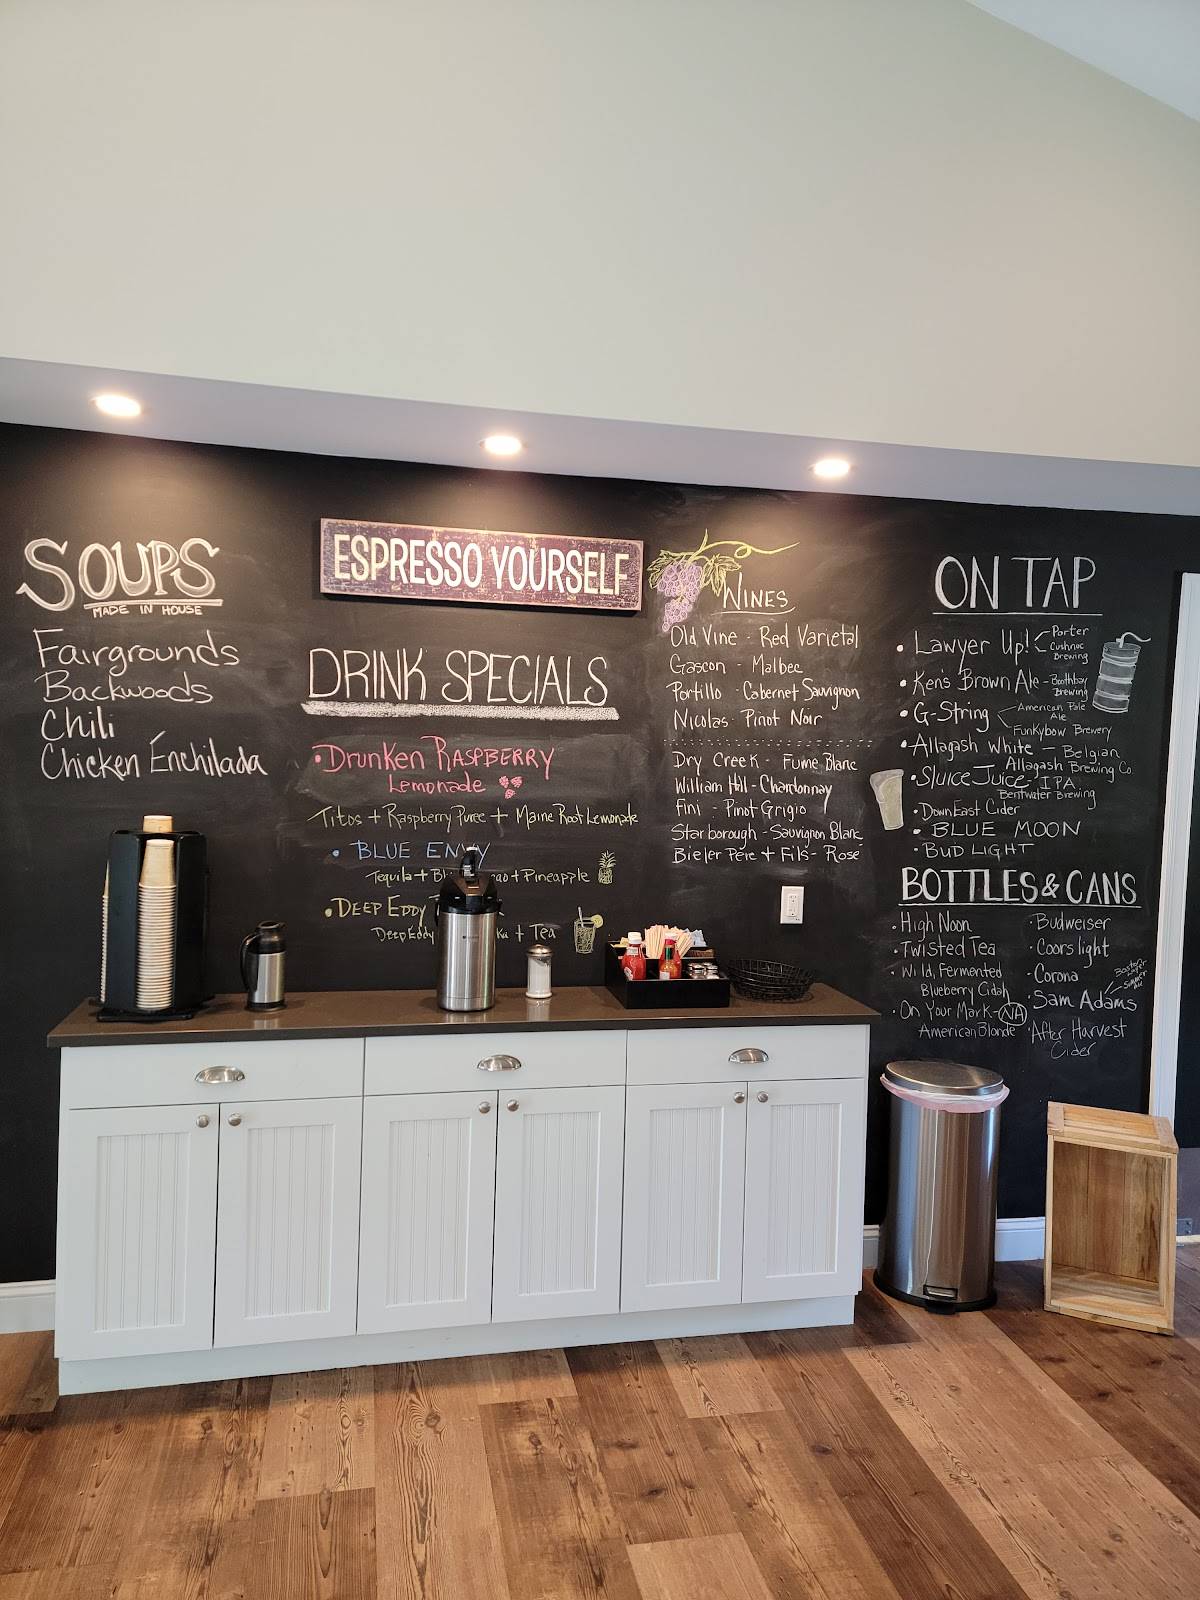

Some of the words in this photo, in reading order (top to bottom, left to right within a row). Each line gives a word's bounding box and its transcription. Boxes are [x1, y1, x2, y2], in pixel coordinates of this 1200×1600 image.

[16, 538, 220, 611] SOUPS
[334, 534, 483, 589] ESPRESSO
[490, 545, 630, 596] YOURSELF
[934, 555, 1000, 610] ON
[1011, 556, 1097, 609] TAP
[93, 605, 130, 618] MADE
[140, 604, 153, 615] IN
[162, 604, 203, 615] HOUSE
[671, 624, 697, 647] Old
[702, 624, 738, 646] Vine
[760, 622, 789, 648] Red
[798, 624, 858, 648] Varietal
[1052, 624, 1090, 638] Porter
[33, 628, 240, 676] Fairgrounds
[914, 630, 991, 675] Lawyer
[1001, 628, 1030, 666] Up!
[1053, 652, 1089, 665] Brewing
[669, 654, 726, 674] Gascon
[752, 654, 803, 674] Malbec
[34, 670, 213, 703] Backwoods
[309, 647, 427, 701] DRINK
[441, 649, 609, 707] SPECIALS
[957, 667, 1011, 692] Brown
[1014, 667, 1040, 695] Ale
[666, 681, 722, 702] Portillo
[1052, 687, 1089, 703] Brewing
[913, 700, 990, 733] G-String
[1017, 702, 1064, 712] American
[1066, 701, 1086, 711] Pale
[1050, 713, 1068, 721] Ale
[41, 705, 115, 741] Chili
[674, 709, 729, 730] Nicolas
[740, 708, 780, 728] Pinot
[790, 707, 823, 726] Noir
[1072, 723, 1113, 743] Brewery
[908, 733, 979, 761] Allagash
[988, 736, 1034, 755] White
[1062, 744, 1120, 765] Belgian
[41, 742, 140, 781] Chicken
[672, 751, 702, 776] Dry
[822, 752, 858, 772] Blanc
[1005, 756, 1064, 780] Allagash
[1067, 760, 1115, 784] Brewing
[389, 771, 487, 793] Lemonade
[675, 777, 723, 795] William
[675, 798, 701, 817] Fini
[723, 798, 758, 819] Pinot
[760, 799, 807, 822] Grigio
[985, 797, 1020, 816] Cider
[1053, 788, 1097, 811] Brewing
[382, 802, 452, 833] Raspberry
[516, 804, 555, 830] Maine
[552, 803, 584, 825] Root
[931, 821, 997, 838] BLUE
[1014, 820, 1082, 838] MOON
[769, 823, 826, 848] Sauvignon
[829, 820, 864, 841] Blanc
[349, 840, 411, 860] BLUE
[672, 846, 722, 864] Bieler
[365, 866, 412, 888] Tequila
[520, 868, 591, 885] Pineapple
[901, 867, 1039, 904] BOTTLES
[1041, 873, 1060, 899] &
[1065, 870, 1138, 905] CANS
[529, 924, 556, 940] Tea
[900, 911, 934, 943] High
[938, 910, 973, 933] Noon
[1033, 912, 1111, 931] Budweiser
[900, 934, 966, 959] Twisted
[968, 935, 996, 957] Tea
[1036, 937, 1074, 956] Coors
[939, 961, 1003, 979] Fermented
[1034, 962, 1079, 984] Corona
[920, 982, 974, 1006] Blueberry
[1033, 989, 1075, 1010] Sam
[1079, 988, 1138, 1012] Adams
[900, 999, 920, 1020] On
[925, 999, 952, 1021] Your
[1000, 1005, 1025, 1022] NA
[918, 1023, 977, 1038] American
[977, 1021, 1016, 1038] Blonde
[1031, 1019, 1067, 1044] After
[1071, 1017, 1128, 1040] Harvest
[1050, 1040, 1097, 1060] Cider
